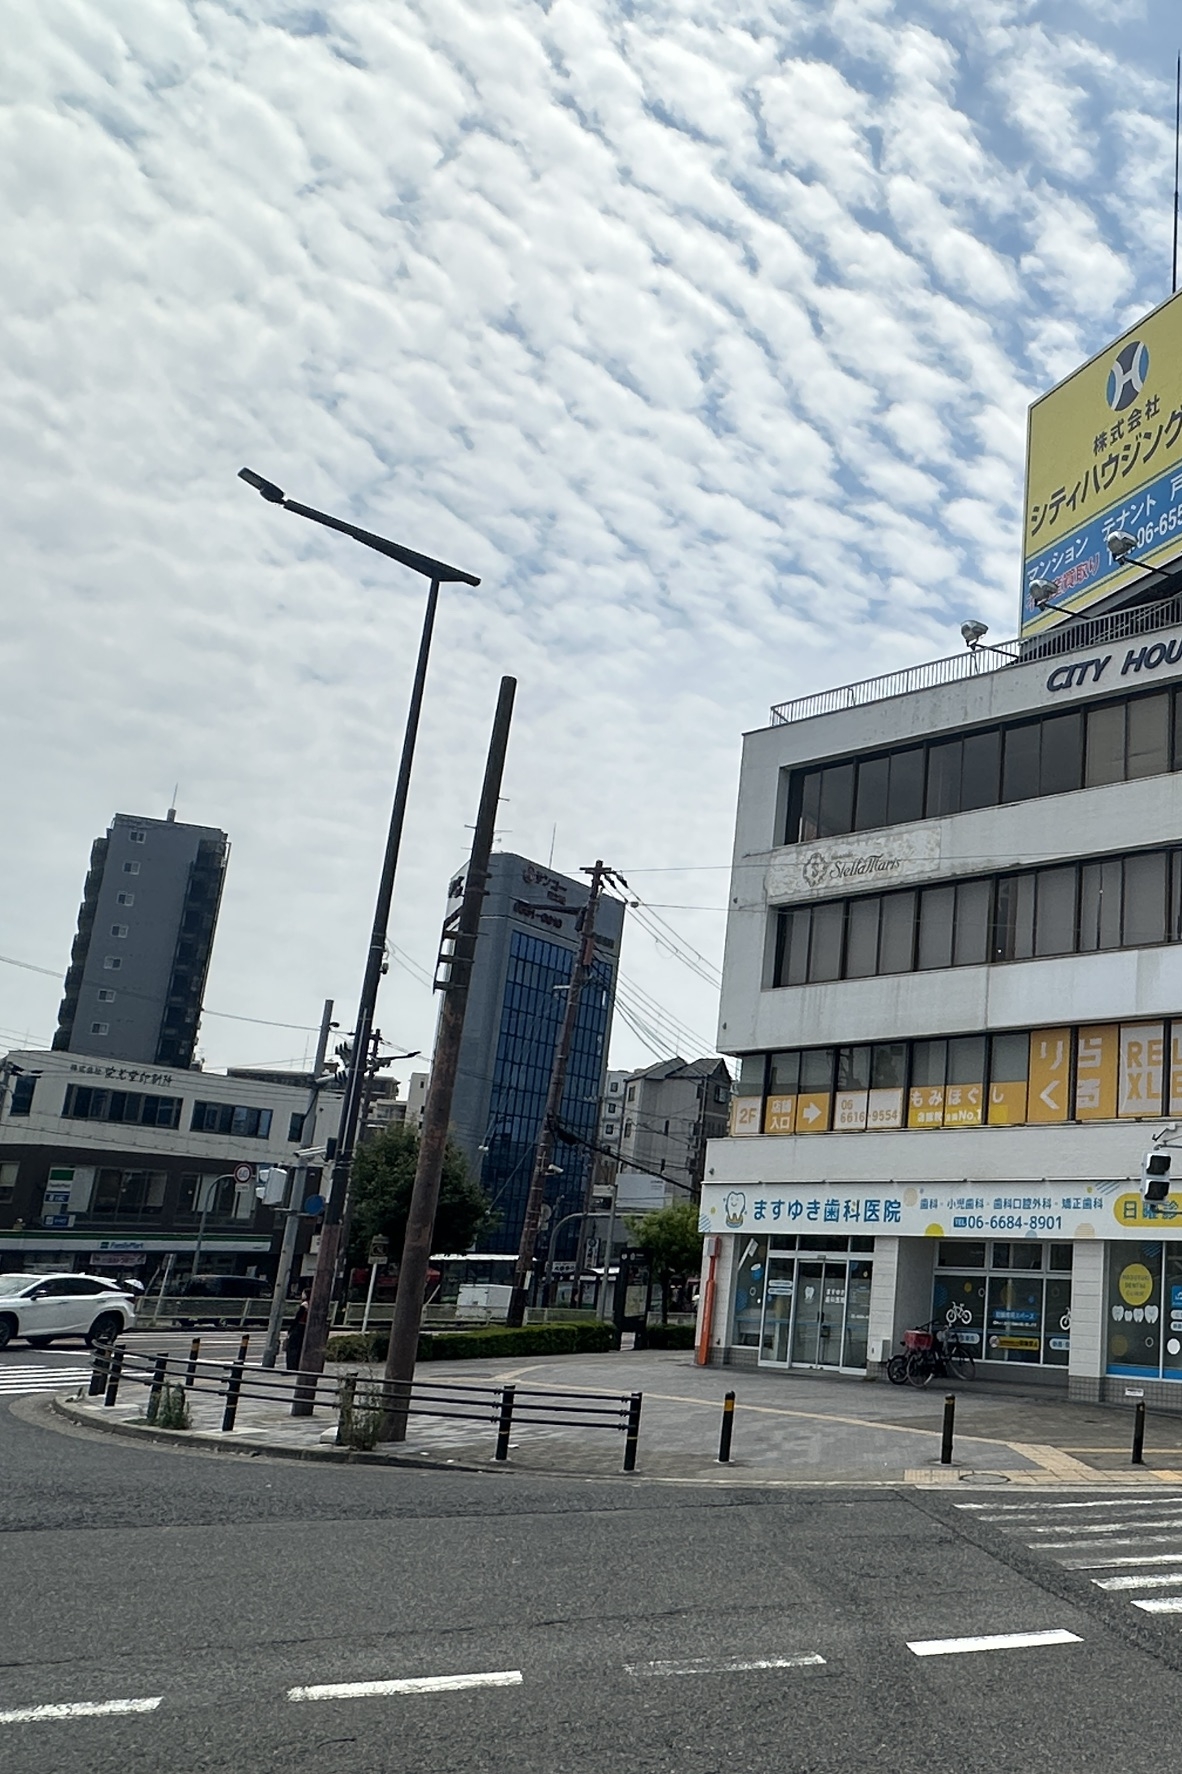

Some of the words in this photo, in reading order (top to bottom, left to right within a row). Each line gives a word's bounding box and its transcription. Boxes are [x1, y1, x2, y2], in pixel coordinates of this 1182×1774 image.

[1093, 394, 1160, 457] 株式会社
[1027, 536, 1089, 581] マンション
[1102, 493, 1156, 541] テナント
[1026, 552, 1100, 613] 産買取り
[1047, 655, 1112, 692] CITY
[841, 1099, 853, 1110] 06
[911, 1086, 1004, 1107] もみほぐし
[739, 1107, 758, 1125] 2F
[771, 1099, 792, 1114] 店舗
[770, 1117, 790, 1130] 入口
[840, 1110, 898, 1123] 6616-9554
[754, 1199, 902, 1223] ますゆき歯科医院
[968, 1215, 1062, 1230] 06-6684-8901
